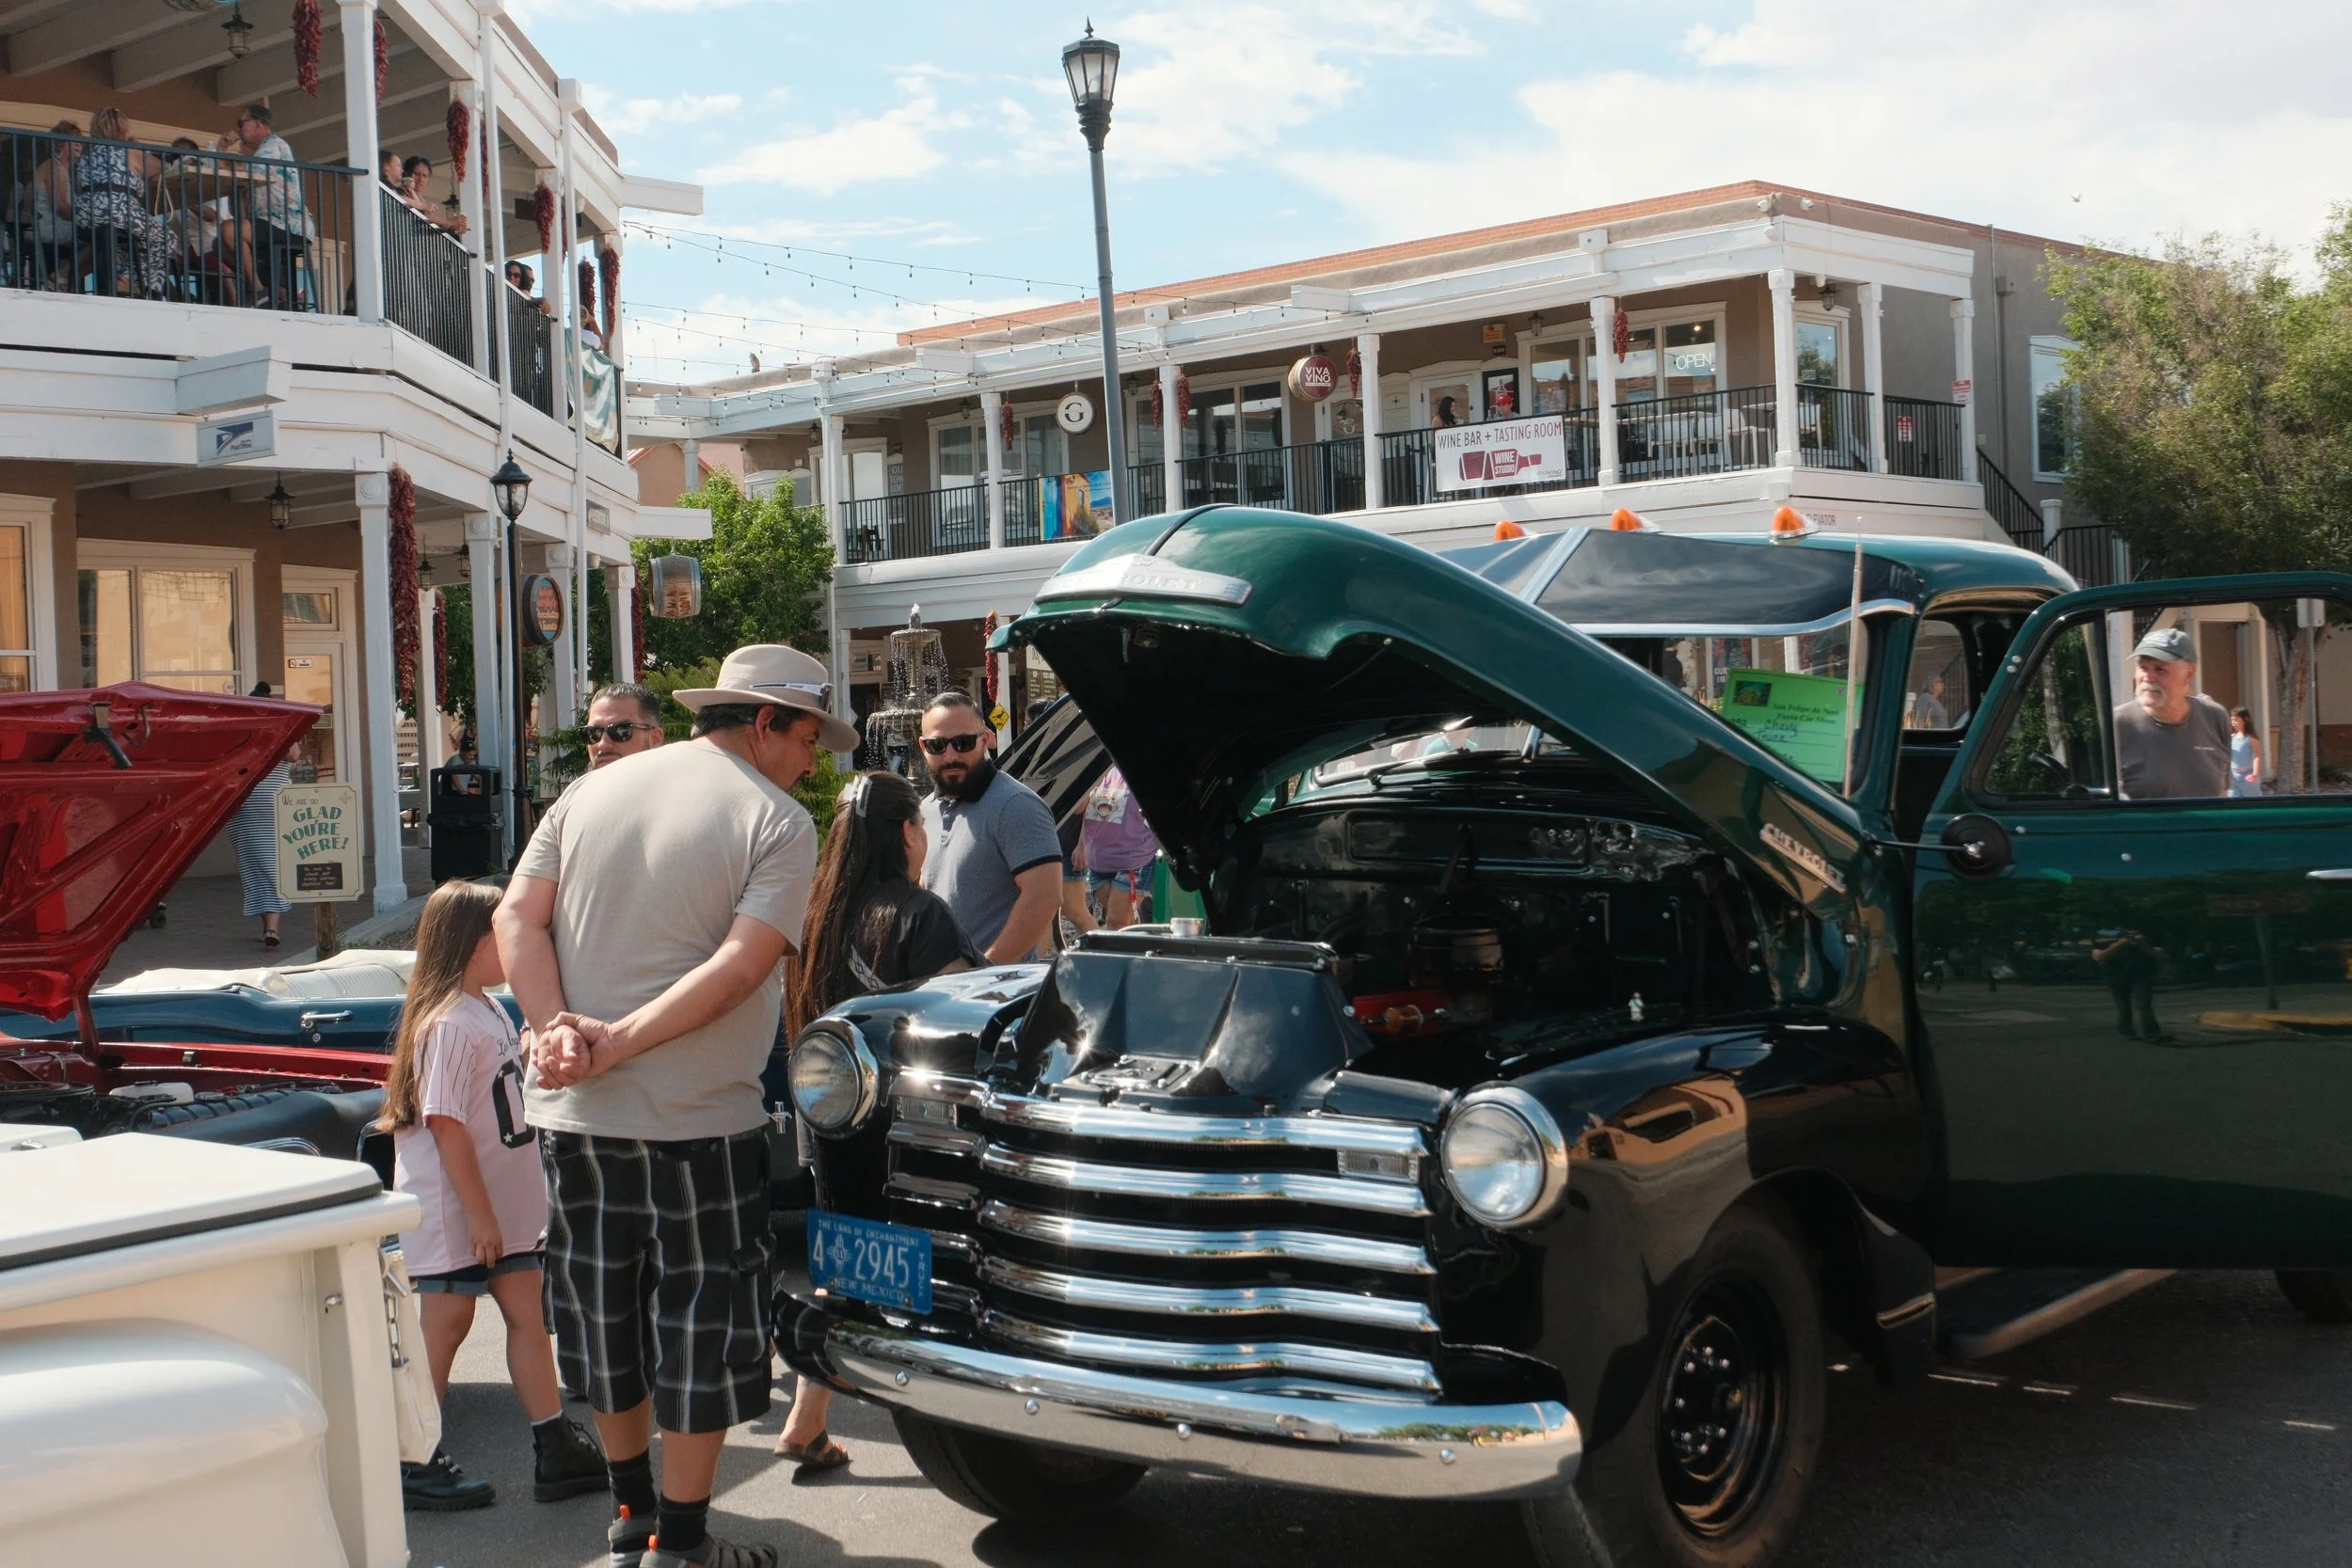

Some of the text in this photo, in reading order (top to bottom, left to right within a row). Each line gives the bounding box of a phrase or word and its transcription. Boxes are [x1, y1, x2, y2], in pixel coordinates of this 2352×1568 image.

[1676, 351, 1711, 370] OPEN
[1305, 367, 1330, 375] VIVA
[1305, 373, 1331, 383] VINO
[1064, 402, 1084, 422] G
[1438, 421, 1562, 450] WINE BAR + TASTING ROOM
[1494, 451, 1515, 464] WINE
[1494, 464, 1515, 475] STUDIO
[890, 475, 903, 483] TOW
[890, 483, 903, 493] LOF
[293, 806, 342, 823] GLAD
[281, 819, 341, 845] YOU'RE
[297, 837, 349, 860] HERE!
[1761, 823, 1846, 891] CHEVROLET
[818, 1219, 831, 1229] THE
[834, 1223, 851, 1235] LAND
[854, 1227, 862, 1236] OF
[813, 1229, 824, 1271] 4
[854, 1238, 910, 1289] 2945
[834, 1277, 904, 1303] NEW MEXICO
